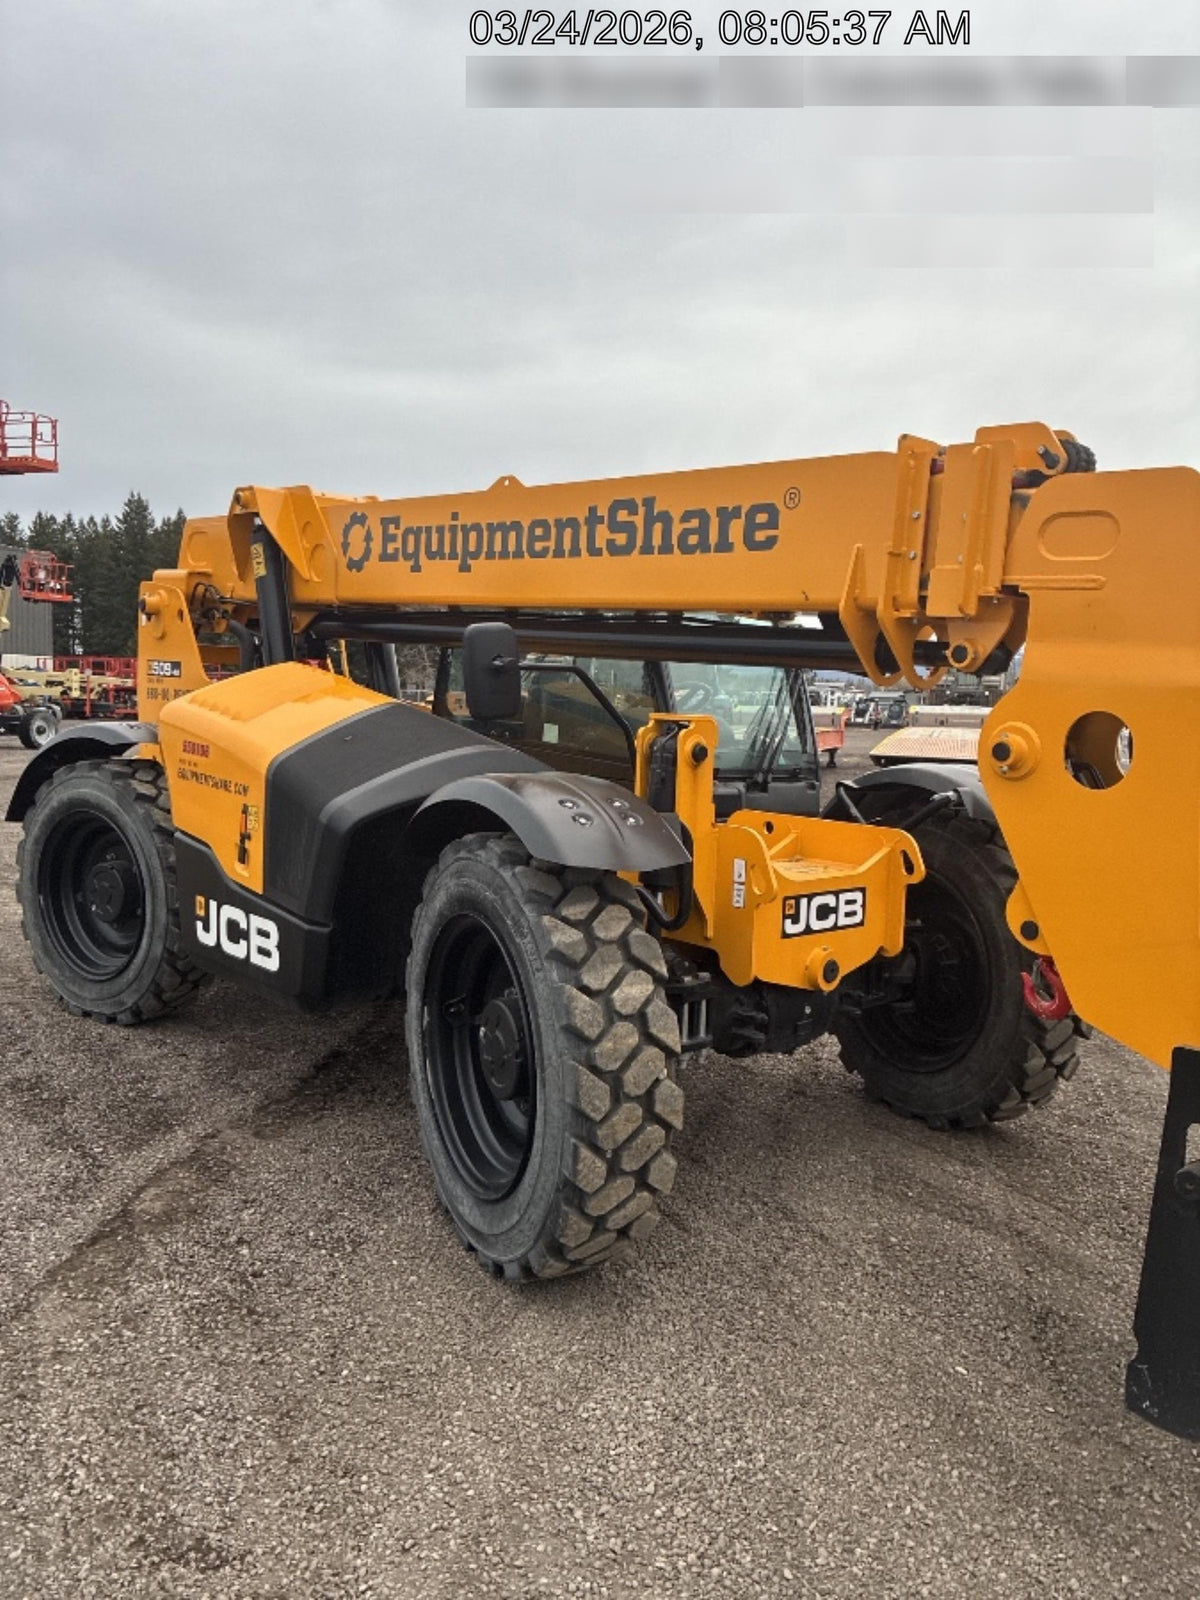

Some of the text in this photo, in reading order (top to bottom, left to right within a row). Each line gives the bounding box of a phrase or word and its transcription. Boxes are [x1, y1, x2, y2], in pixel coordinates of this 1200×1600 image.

[378, 496, 781, 573] EquipmentShare
[195, 896, 280, 972] JCB
[784, 891, 864, 934] JCB
